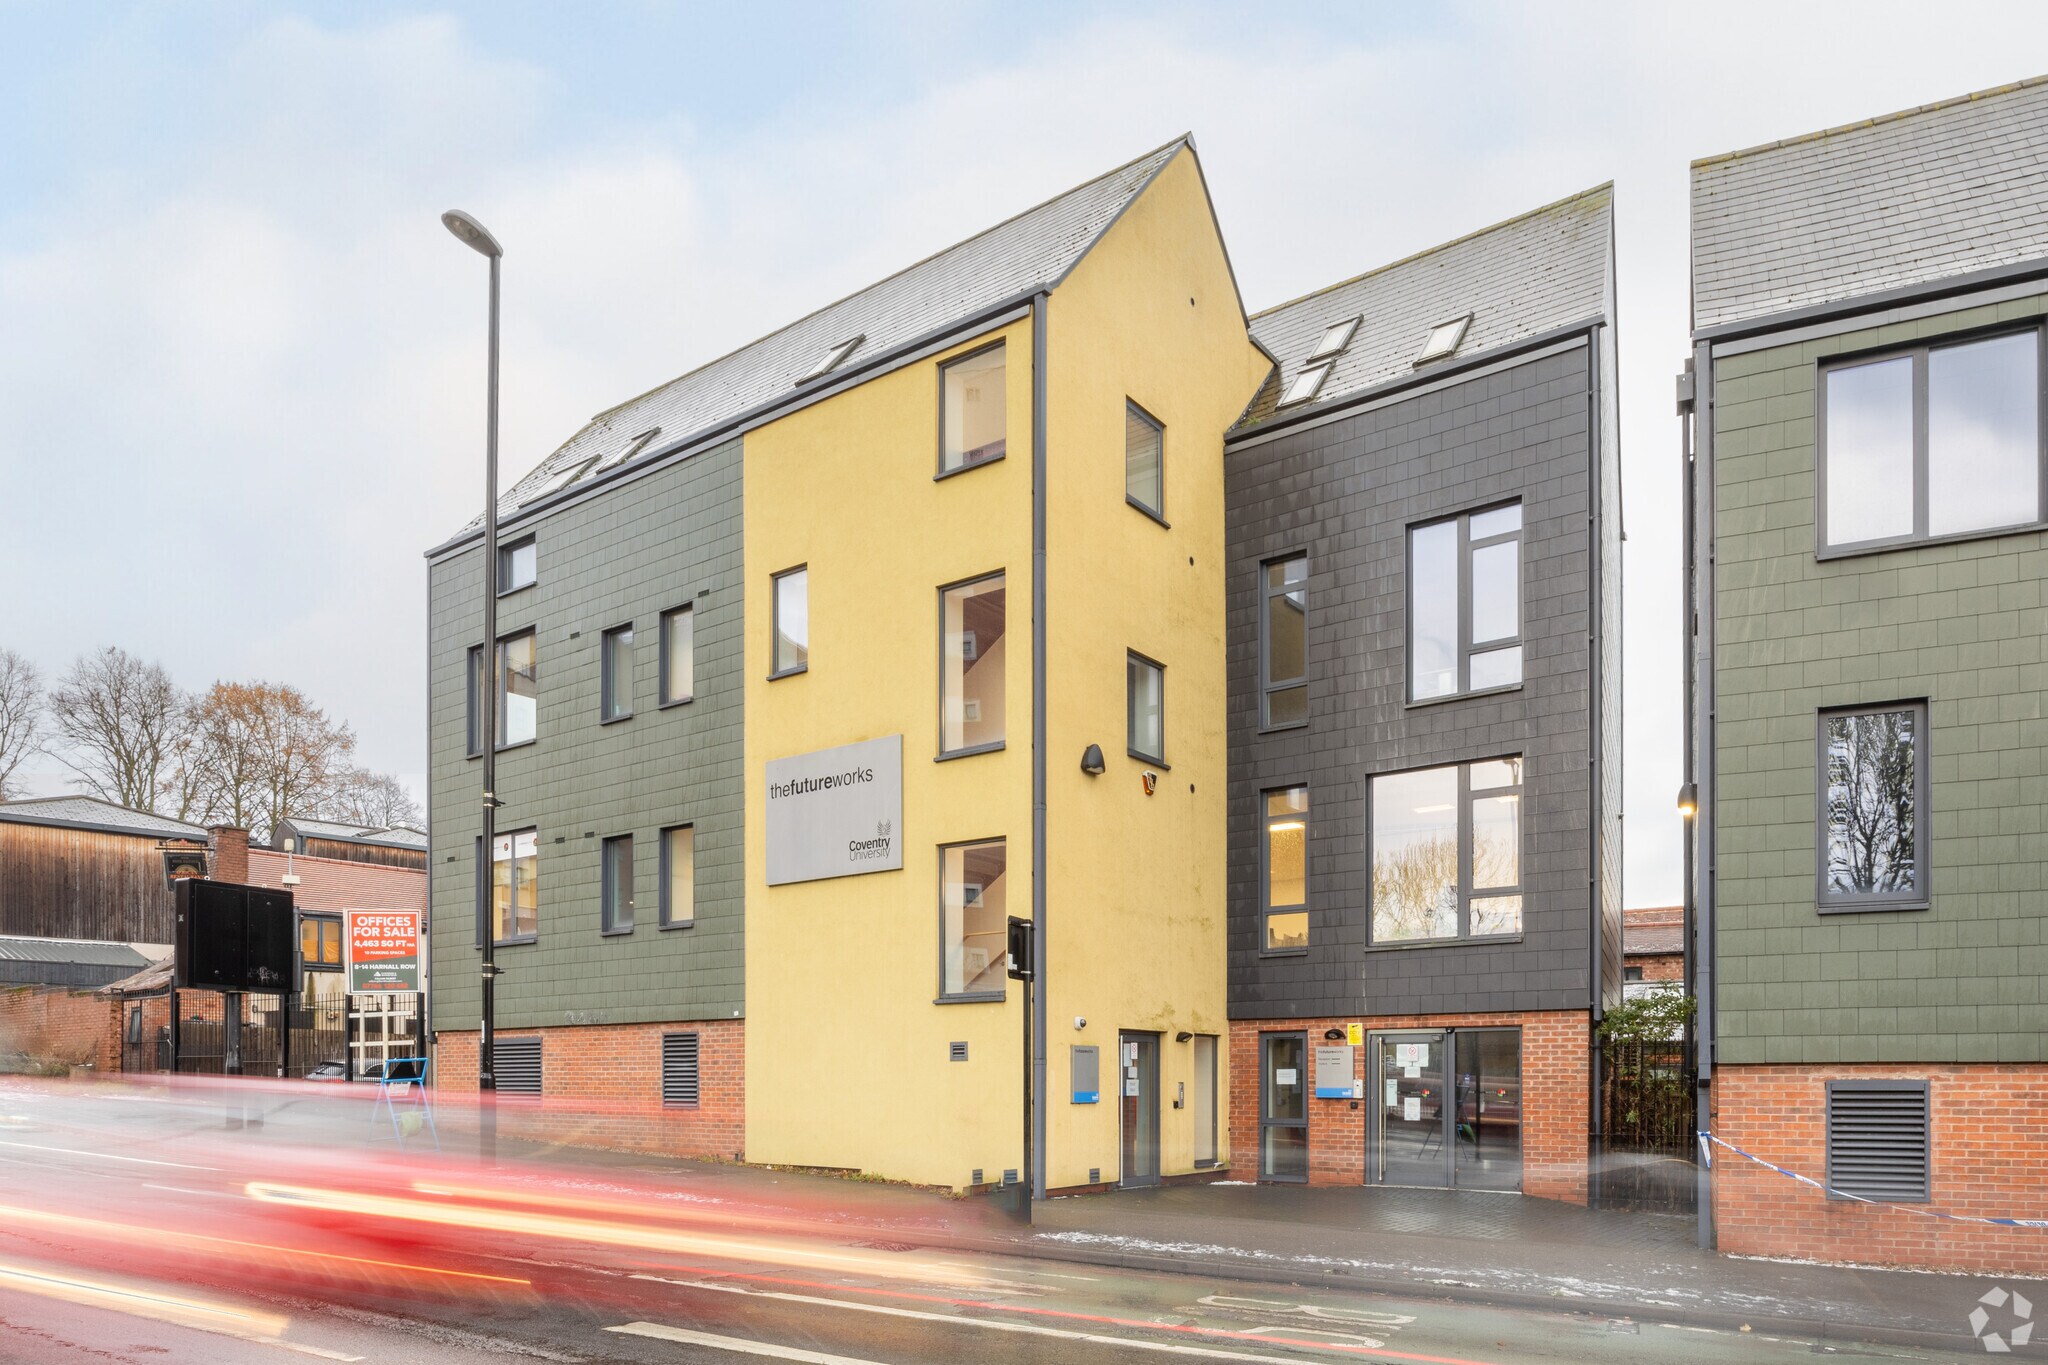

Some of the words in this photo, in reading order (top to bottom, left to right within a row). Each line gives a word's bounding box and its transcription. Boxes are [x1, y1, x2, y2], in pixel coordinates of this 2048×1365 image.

[770, 766, 874, 800] thefutureworks
[848, 837, 891, 852] Coventry
[849, 847, 891, 862] University
[356, 916, 411, 926] OFFICES
[353, 927, 380, 937] FOR
[383, 927, 415, 937] SALE
[354, 940, 380, 948] 4,463
